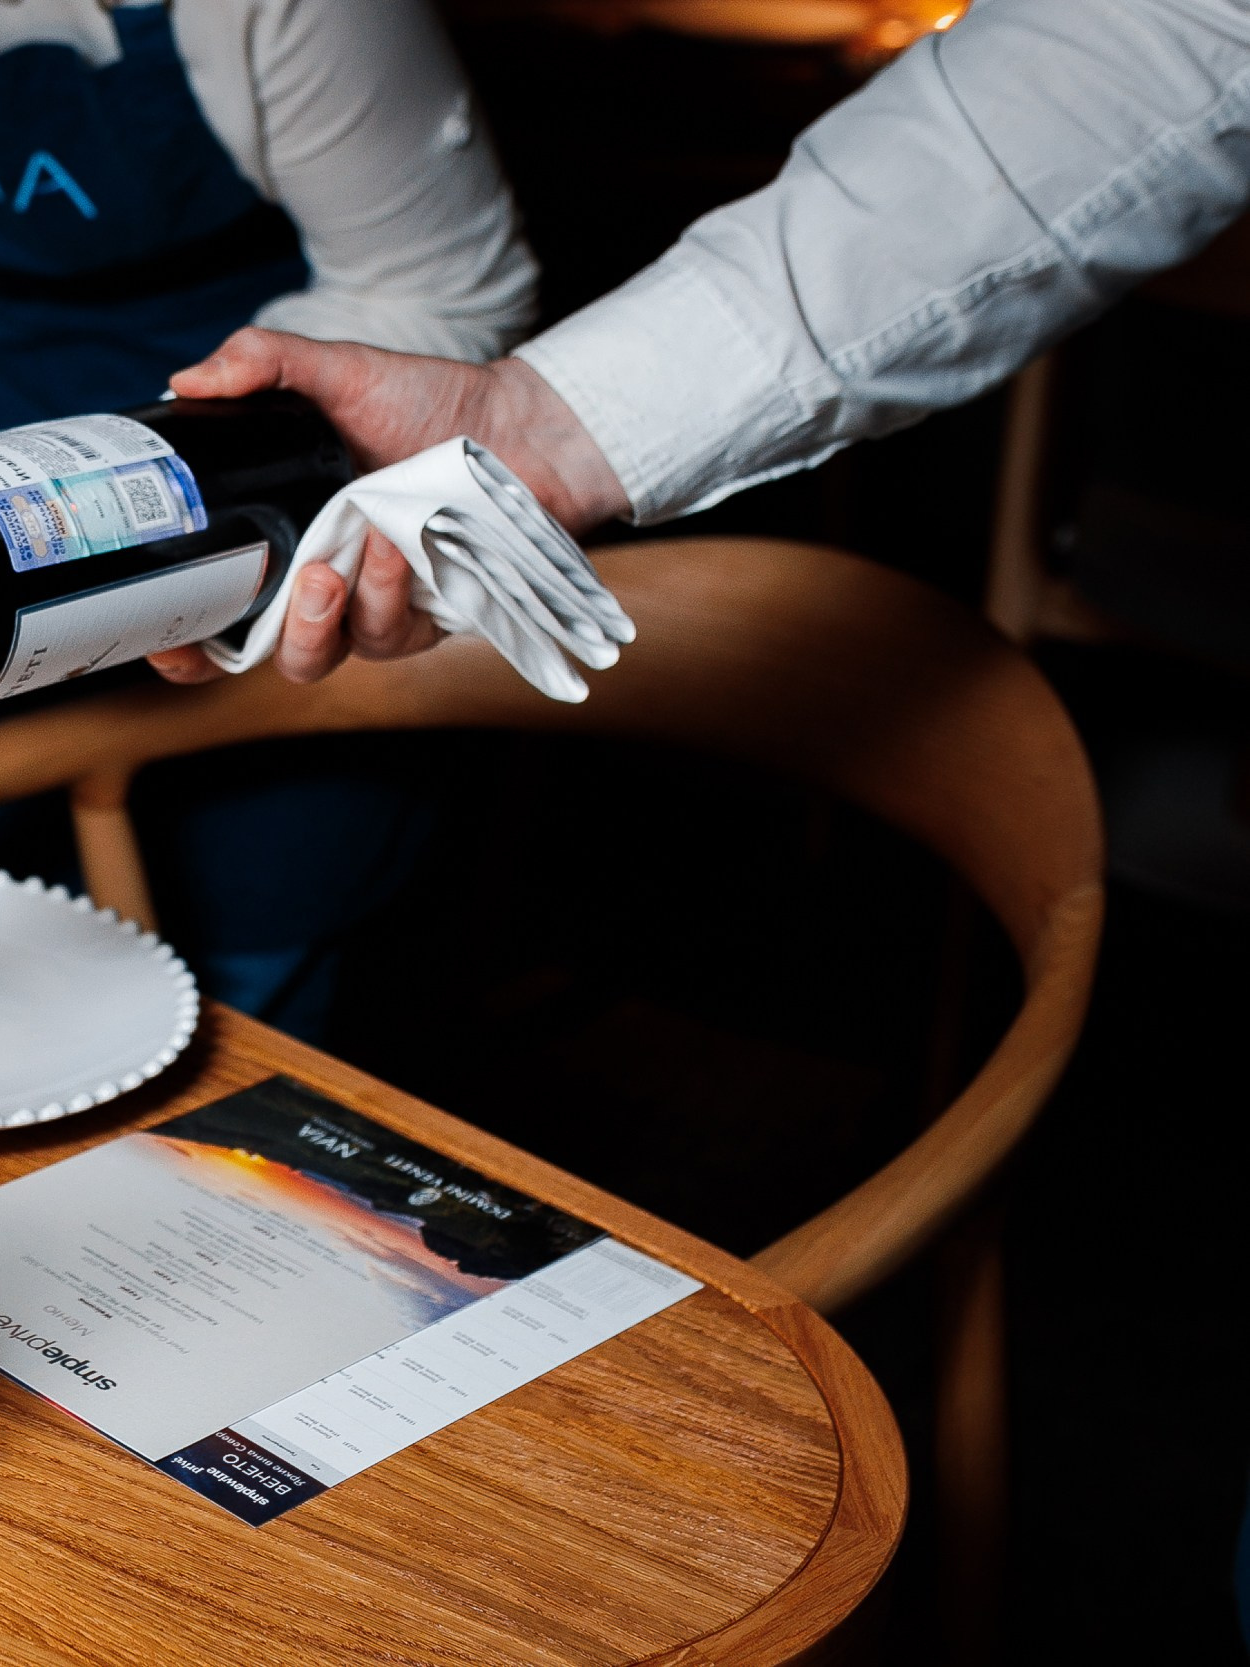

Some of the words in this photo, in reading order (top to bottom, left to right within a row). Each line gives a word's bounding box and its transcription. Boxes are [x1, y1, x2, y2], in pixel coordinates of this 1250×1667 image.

[1, 497, 33, 560] ФЕДЕРАЦИЯ
[43, 1304, 94, 1338] Меню
[171, 1456, 203, 1475] privé
[222, 1453, 293, 1496] ВЕНЕТО
[246, 1449, 272, 1466] вина
[206, 1467, 269, 1507] simplewine
[271, 1463, 307, 1487] Яркие
